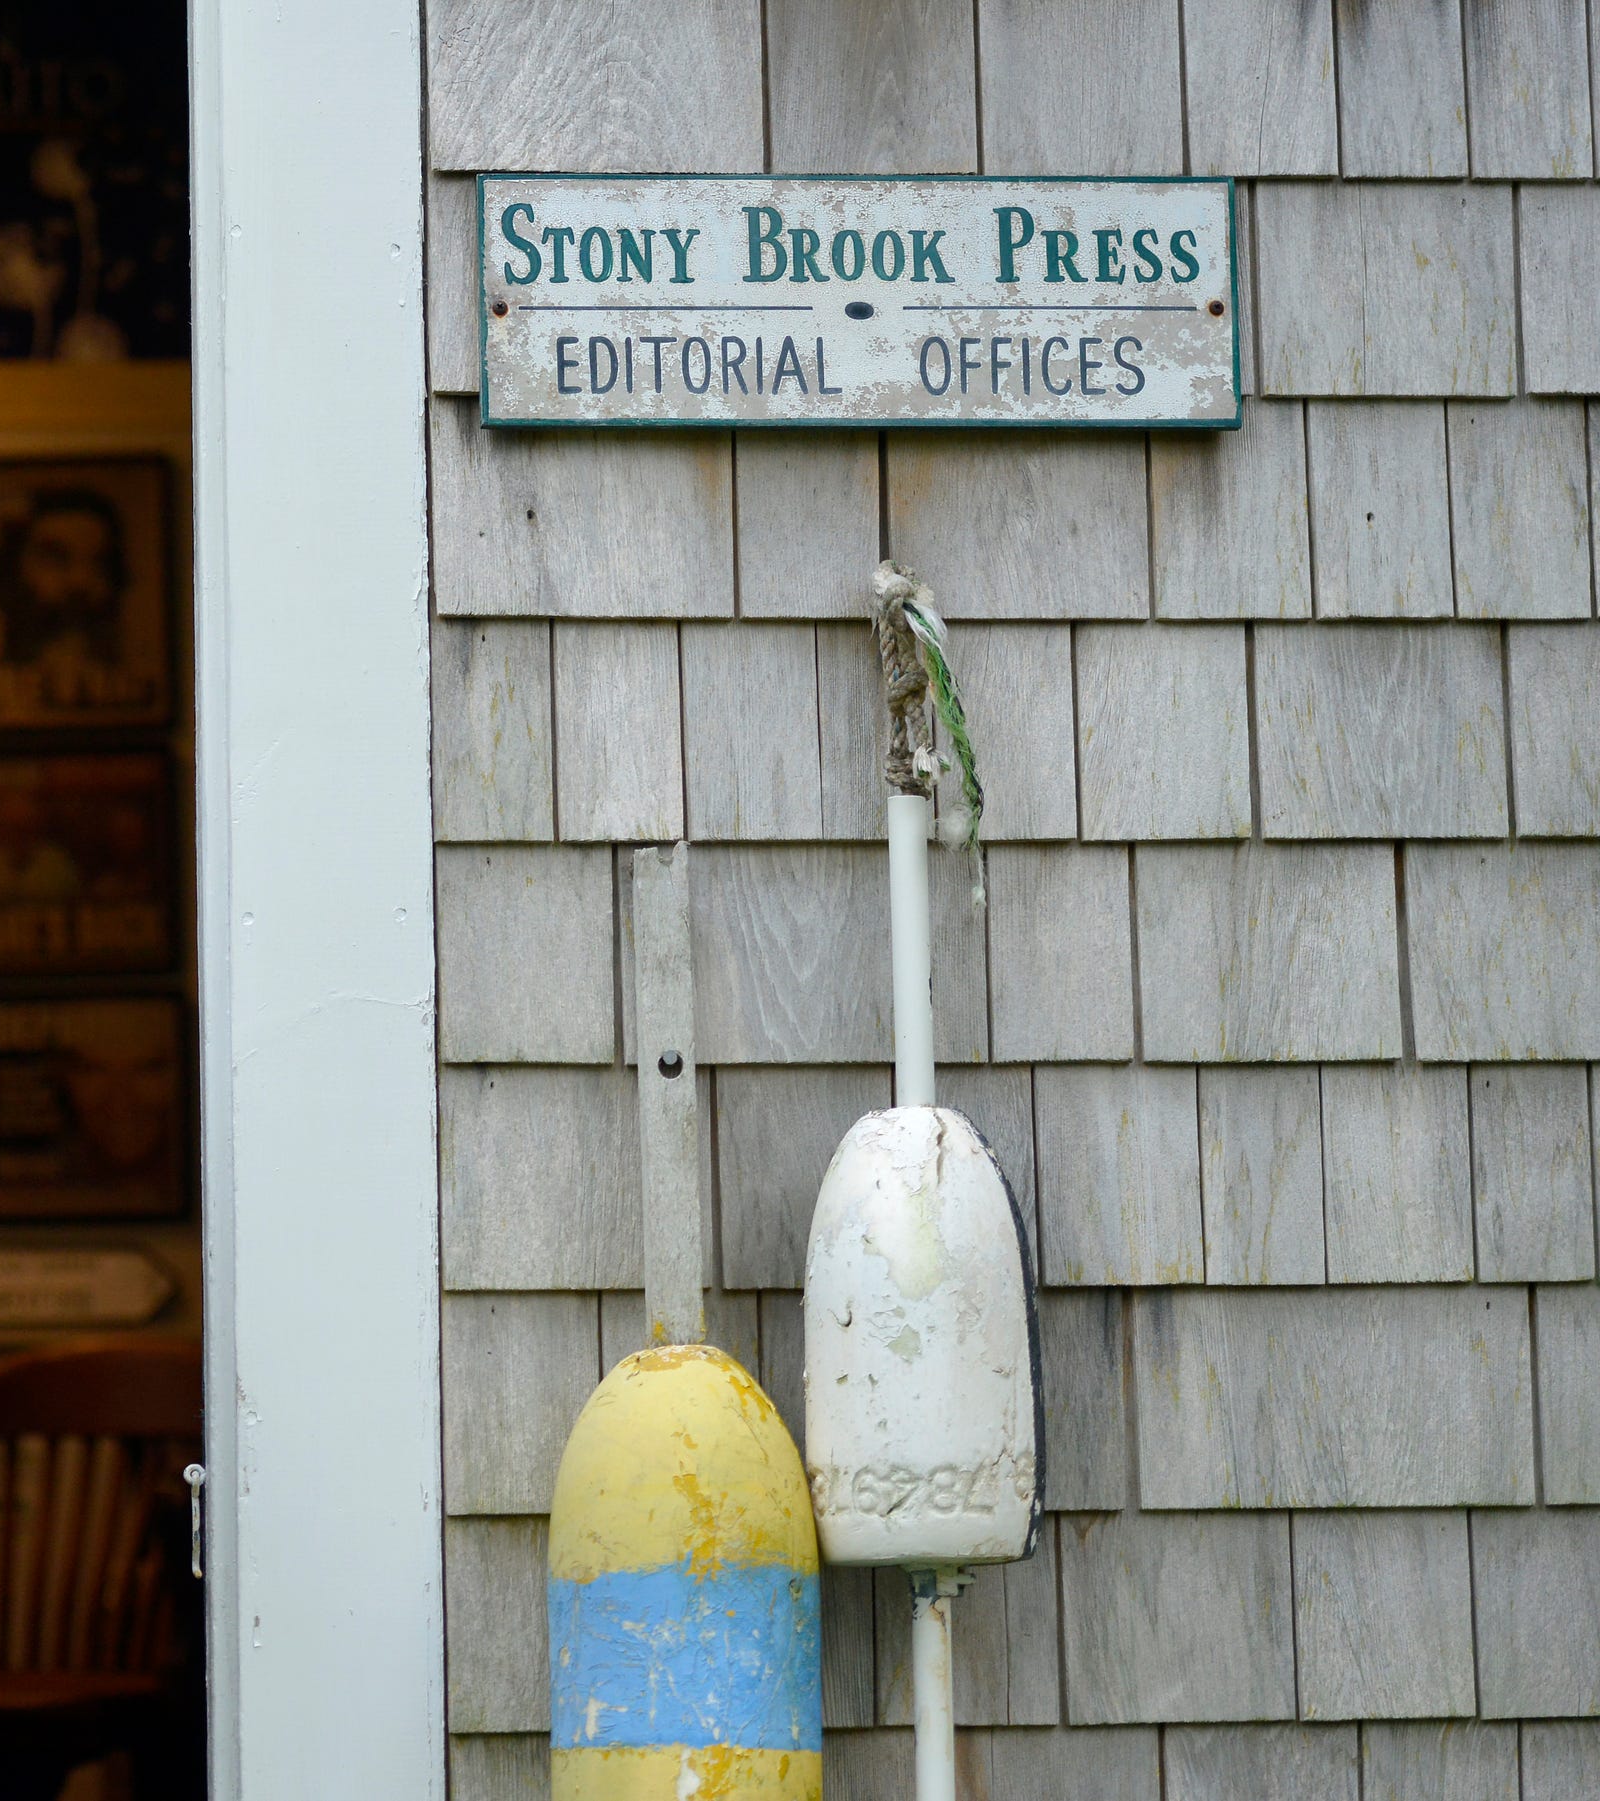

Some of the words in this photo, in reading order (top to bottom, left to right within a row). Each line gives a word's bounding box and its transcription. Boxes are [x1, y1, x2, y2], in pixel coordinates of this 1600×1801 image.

[500, 203, 701, 285] STONY
[742, 206, 955, 284] BROOK
[992, 206, 1200, 284] PRESS
[556, 335, 843, 395] EDITORIAL
[919, 336, 1146, 396] OFFICES
